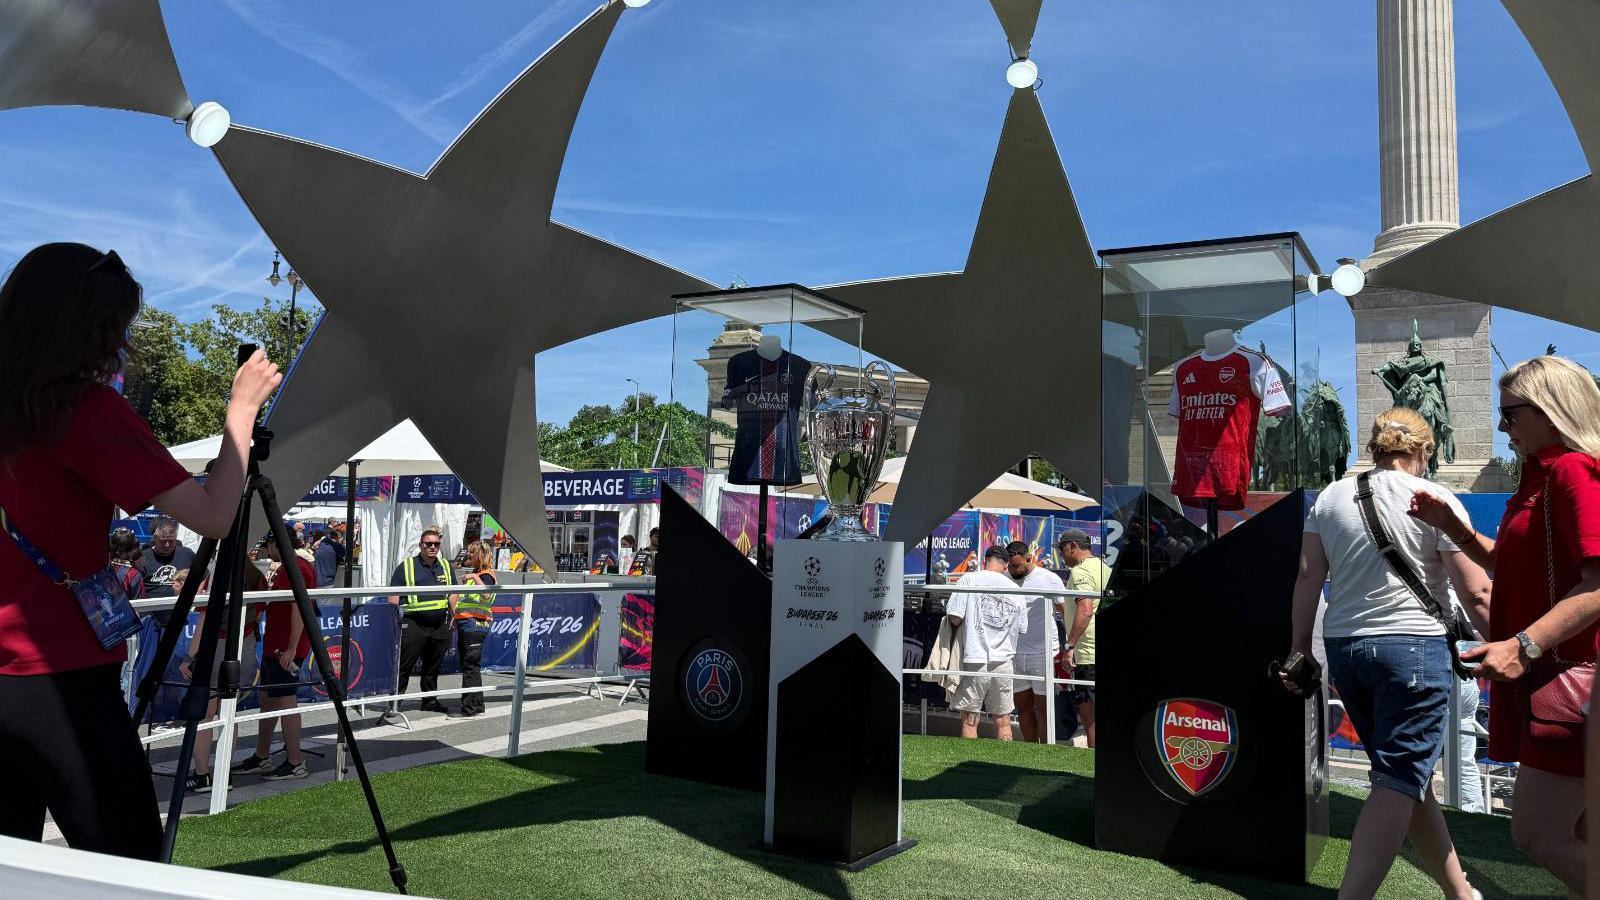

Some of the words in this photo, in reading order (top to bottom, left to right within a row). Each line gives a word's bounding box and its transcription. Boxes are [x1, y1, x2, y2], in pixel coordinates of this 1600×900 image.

[746, 392, 789, 405] QATAR
[1181, 392, 1238, 409] Emirates
[1184, 408, 1195, 421] FLY
[1196, 406, 1225, 419] BETTER
[544, 478, 625, 497] BEVERAGE
[949, 537, 971, 549] LEAGUE
[320, 614, 370, 631] LEAUE
[786, 608, 827, 621] BUDAPEST
[826, 611, 839, 621] 26
[559, 615, 584, 634] 26
[799, 621, 824, 630] FINAL
[696, 652, 734, 672] PARIS
[1165, 711, 1227, 733] Arsenal
